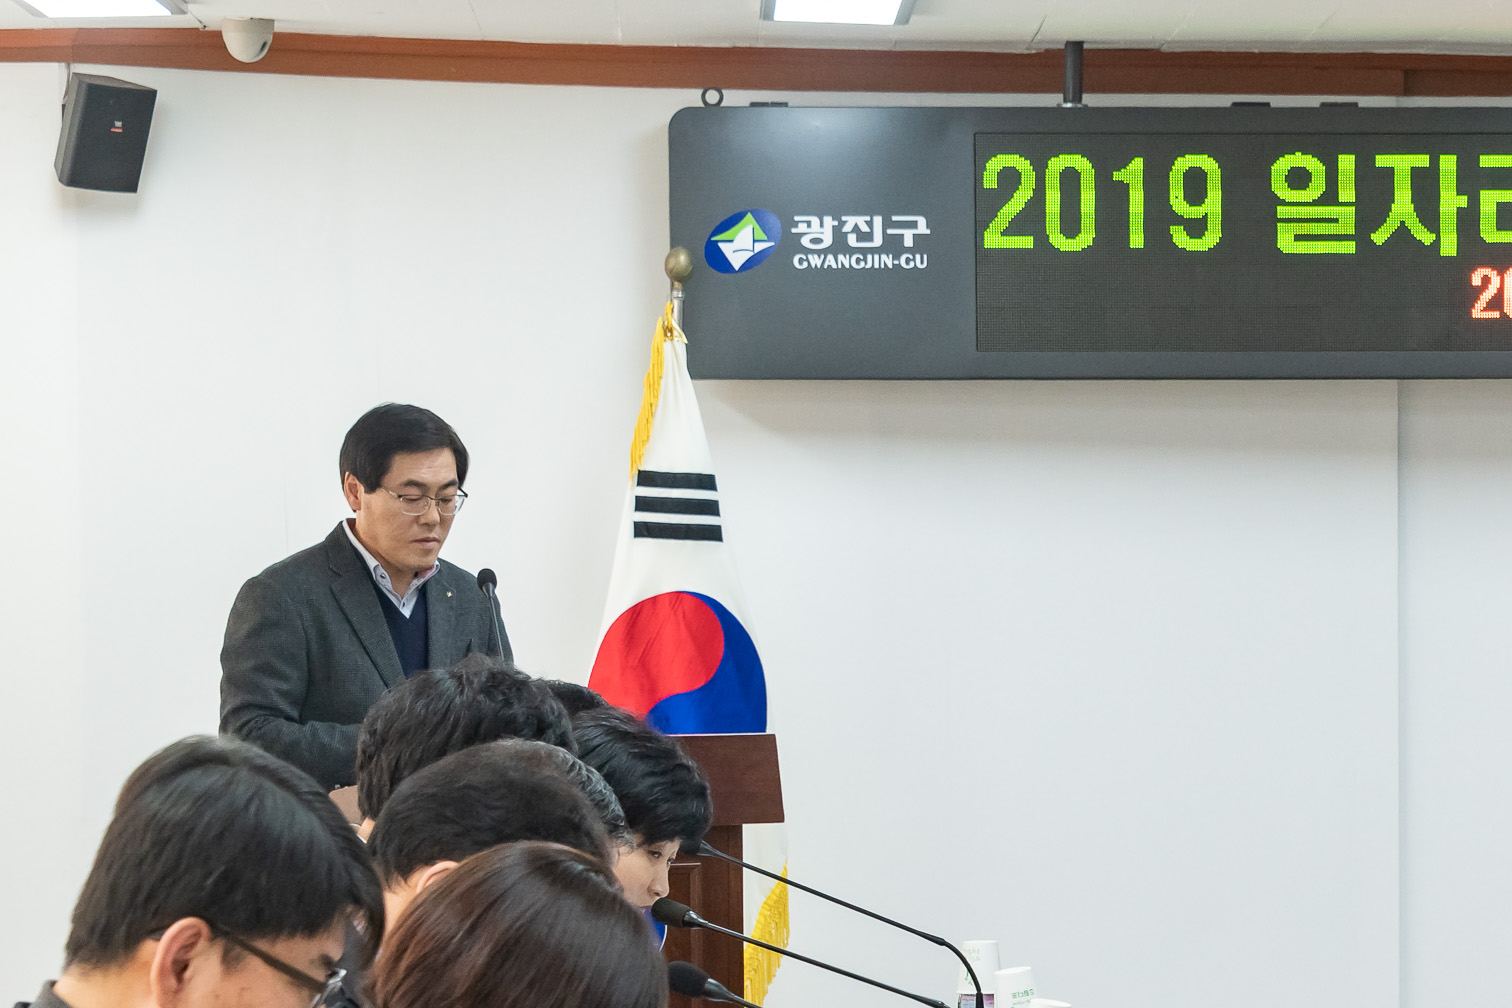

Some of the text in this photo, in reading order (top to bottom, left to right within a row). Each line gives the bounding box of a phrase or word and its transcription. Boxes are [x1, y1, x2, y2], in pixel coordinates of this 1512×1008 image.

[981, 153, 1223, 252] 2019
[790, 214, 931, 250] 광진구
[792, 252, 929, 270] GWANGJIN-GU
